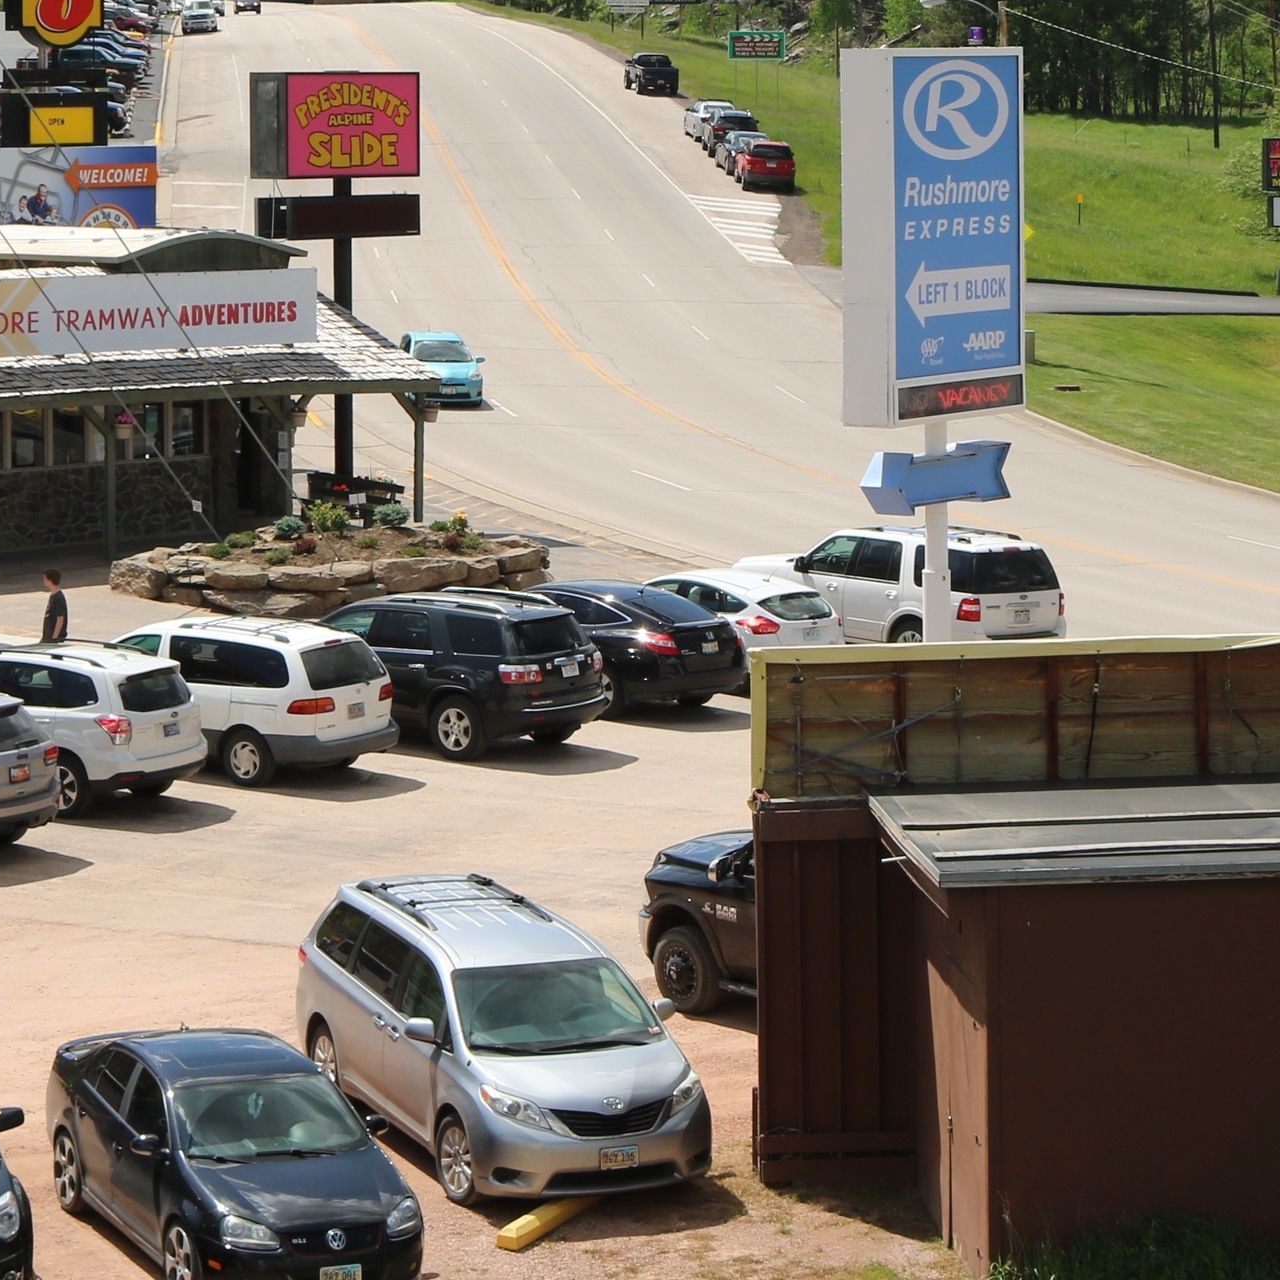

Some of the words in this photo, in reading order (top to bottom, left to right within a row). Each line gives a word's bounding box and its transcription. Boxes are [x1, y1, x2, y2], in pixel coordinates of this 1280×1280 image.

[294, 81, 411, 129] PRESIDENT'S
[48, 118, 65, 126] OPEN
[328, 112, 374, 127] ALPINE
[307, 131, 399, 168] SLIDE
[79, 168, 148, 184] WELCOME!
[904, 175, 1010, 208] Rushmore
[904, 214, 1010, 241] EXPRESS
[918, 282, 949, 305] LEFT
[953, 281, 959, 302] 1
[965, 277, 1006, 301] BLOCK
[53, 306, 168, 333] TRAMWAY
[178, 301, 296, 328] ADVENTURES
[964, 331, 1005, 351] AARP
[938, 383, 1011, 408] VACANCY
